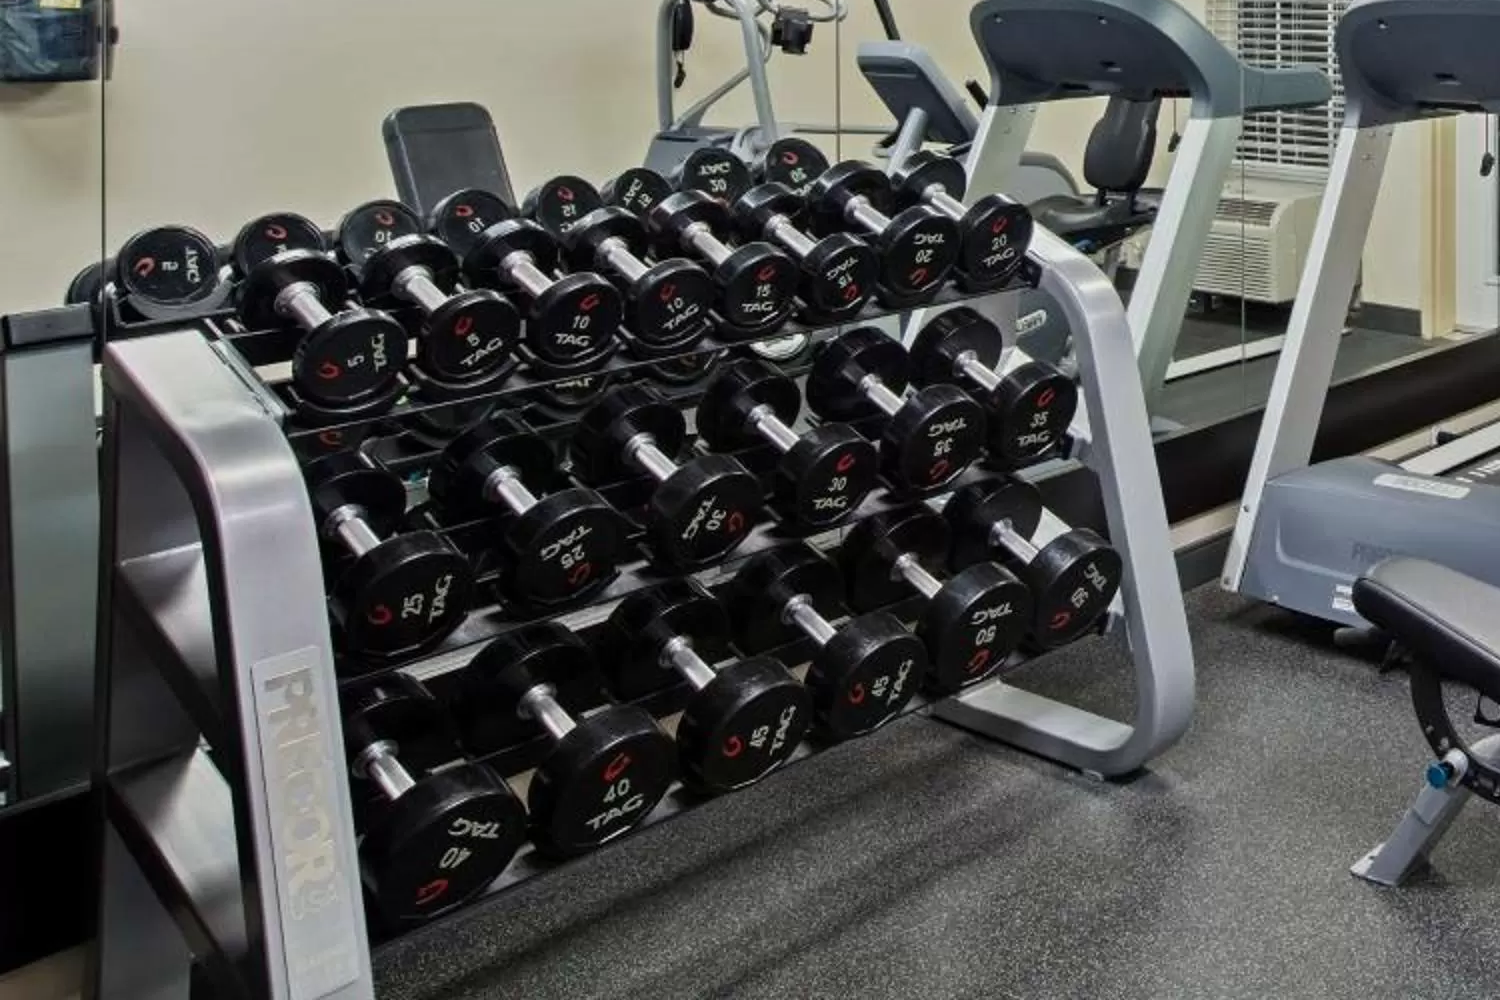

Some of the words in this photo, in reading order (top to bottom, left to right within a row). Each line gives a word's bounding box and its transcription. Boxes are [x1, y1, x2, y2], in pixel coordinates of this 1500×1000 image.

[913, 232, 945, 246] TAG
[992, 233, 1008, 250] 20
[915, 249, 933, 263] 20
[983, 247, 1015, 268] TAG
[825, 256, 859, 281] TAG
[756, 283, 772, 298] 15
[667, 296, 684, 314] 10
[742, 301, 774, 313] TAG
[572, 314, 592, 330] 10
[661, 303, 700, 331] TAG
[554, 332, 592, 347] TAG
[371, 332, 388, 373] TAG
[460, 337, 504, 367] TAG
[928, 417, 968, 437] TAG
[1030, 411, 1049, 428] 35
[1017, 431, 1051, 448] TAG
[827, 476, 848, 492] 30
[812, 496, 849, 510] TAG
[681, 495, 717, 541] TAG
[705, 509, 727, 531] 30
[540, 525, 593, 561] TAG
[560, 544, 586, 569] 25
[402, 593, 425, 619] 25
[428, 573, 455, 625] TAG
[970, 602, 1013, 625] TAG
[975, 624, 997, 646] 50
[871, 675, 890, 697] 45
[886, 659, 914, 708] TAG
[749, 724, 770, 749] 45
[768, 704, 797, 757] TAG
[602, 777, 631, 803] 40
[584, 792, 645, 831] TAG
[448, 816, 500, 839] TAG
[439, 846, 473, 869] 40
